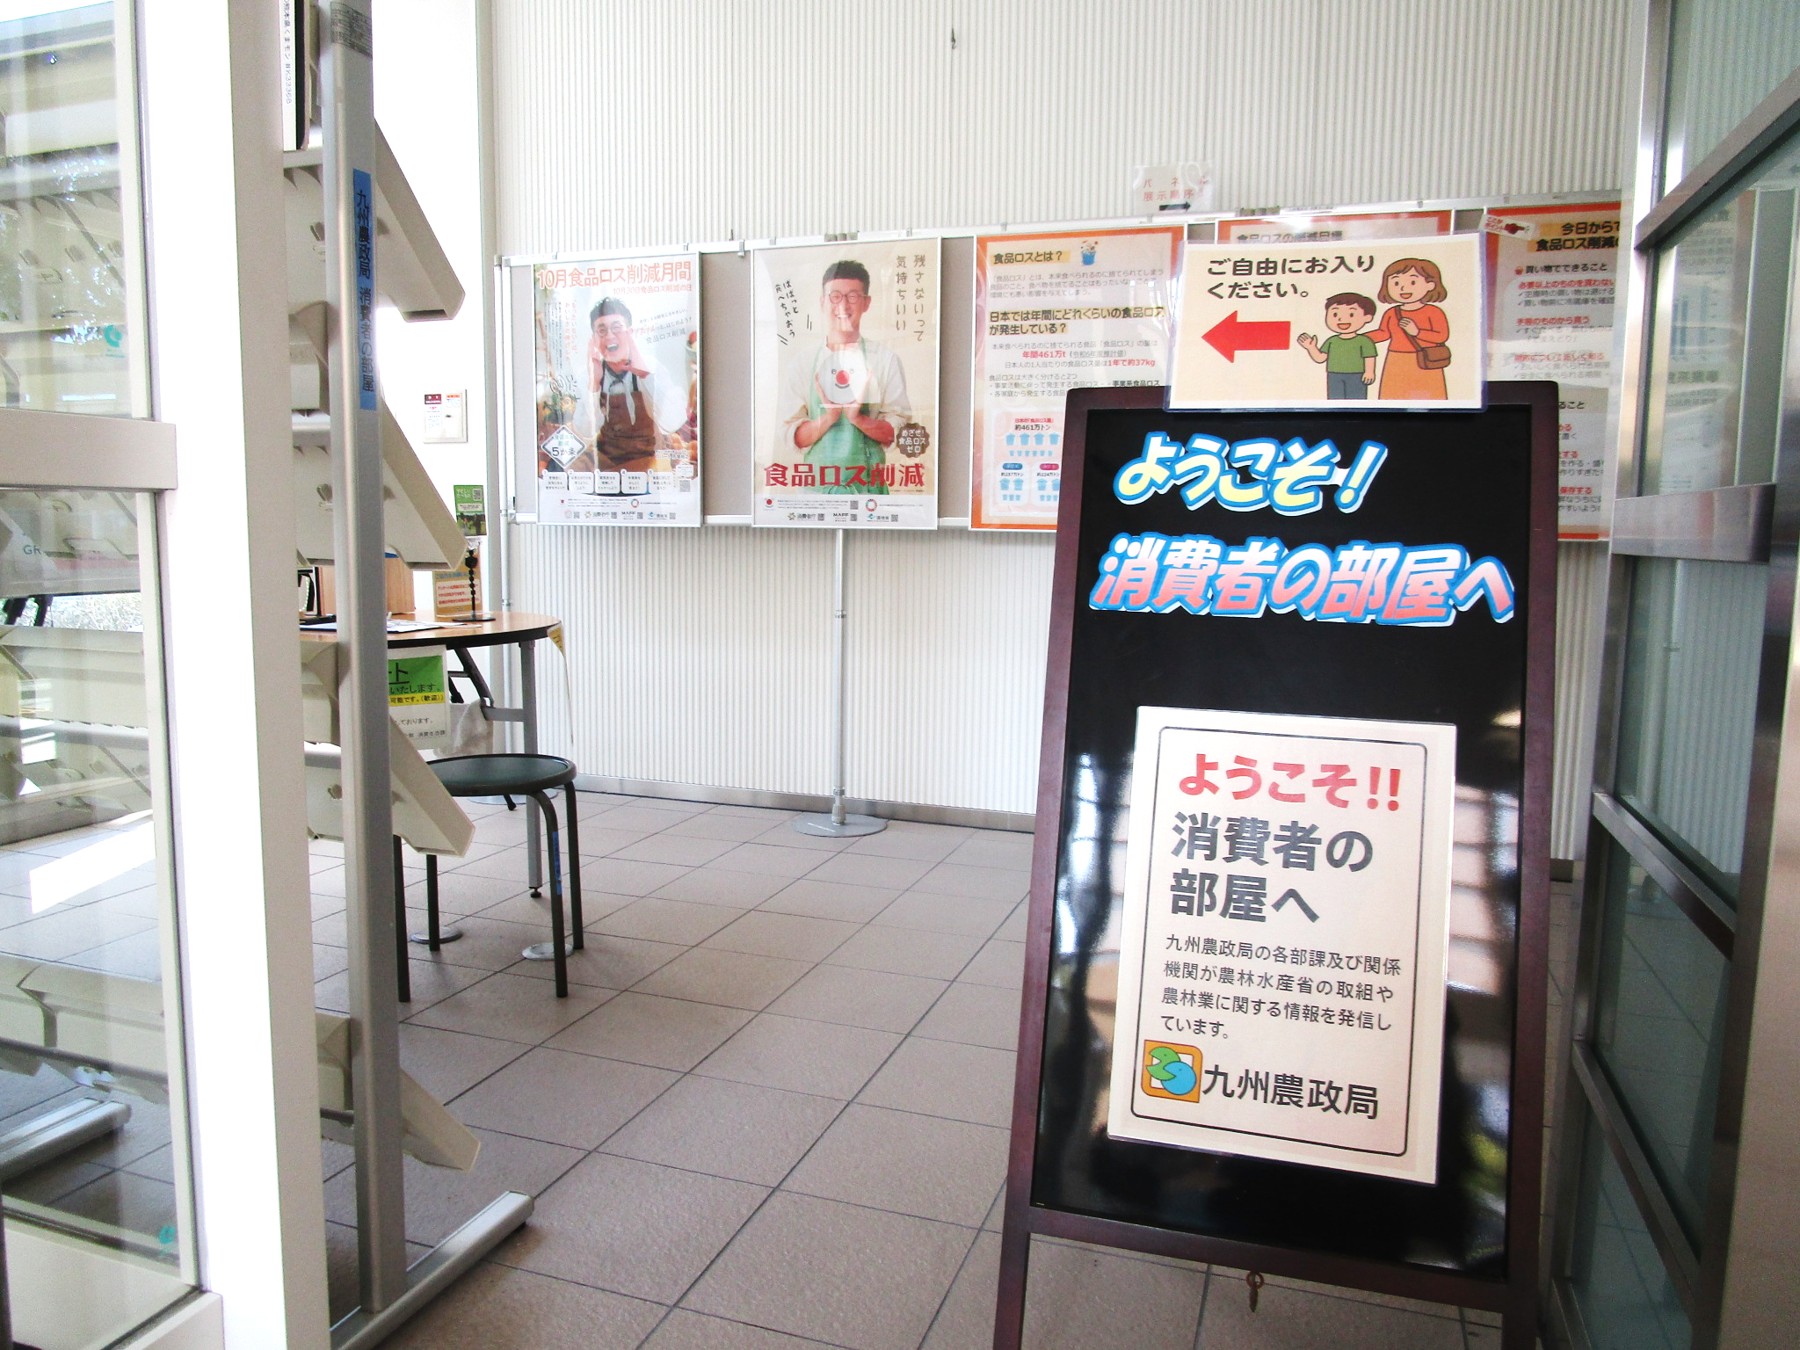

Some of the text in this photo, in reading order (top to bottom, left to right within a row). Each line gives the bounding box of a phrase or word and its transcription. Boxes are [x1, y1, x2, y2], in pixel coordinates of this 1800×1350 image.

[536, 261, 692, 290] 10月食品ロス削減月間
[993, 250, 1063, 264] 食品ロスとは？
[1207, 254, 1375, 276] ご自由にお入り
[358, 189, 374, 392] 九州農政局 消費者の部屋
[895, 255, 907, 332] 気持ちいい
[913, 254, 926, 342] 残さないって
[1207, 281, 1309, 300] ください。
[989, 306, 1165, 323] 日本では年間にどれくらいの食品ロス
[989, 323, 1067, 336] が発生している？
[898, 437, 927, 446] 食品ロス
[906, 445, 921, 454] ゼロ
[764, 462, 925, 488] 食品ロス削減
[1089, 532, 1515, 627] 消費者の部屋へ
[1178, 753, 1402, 812] ようこそ!!
[1171, 811, 1374, 873] 消費者の
[1170, 868, 1321, 923] 部屋へ
[1165, 933, 1402, 977] 九州農政局の各部課及び関係
[1163, 960, 1394, 1003] 機関が農林水産省の取組や
[1160, 1014, 1230, 1040] ています。
[1161, 986, 1393, 1032] 農林業に関する情報を発信し
[1201, 1063, 1379, 1120] 九州農政局
